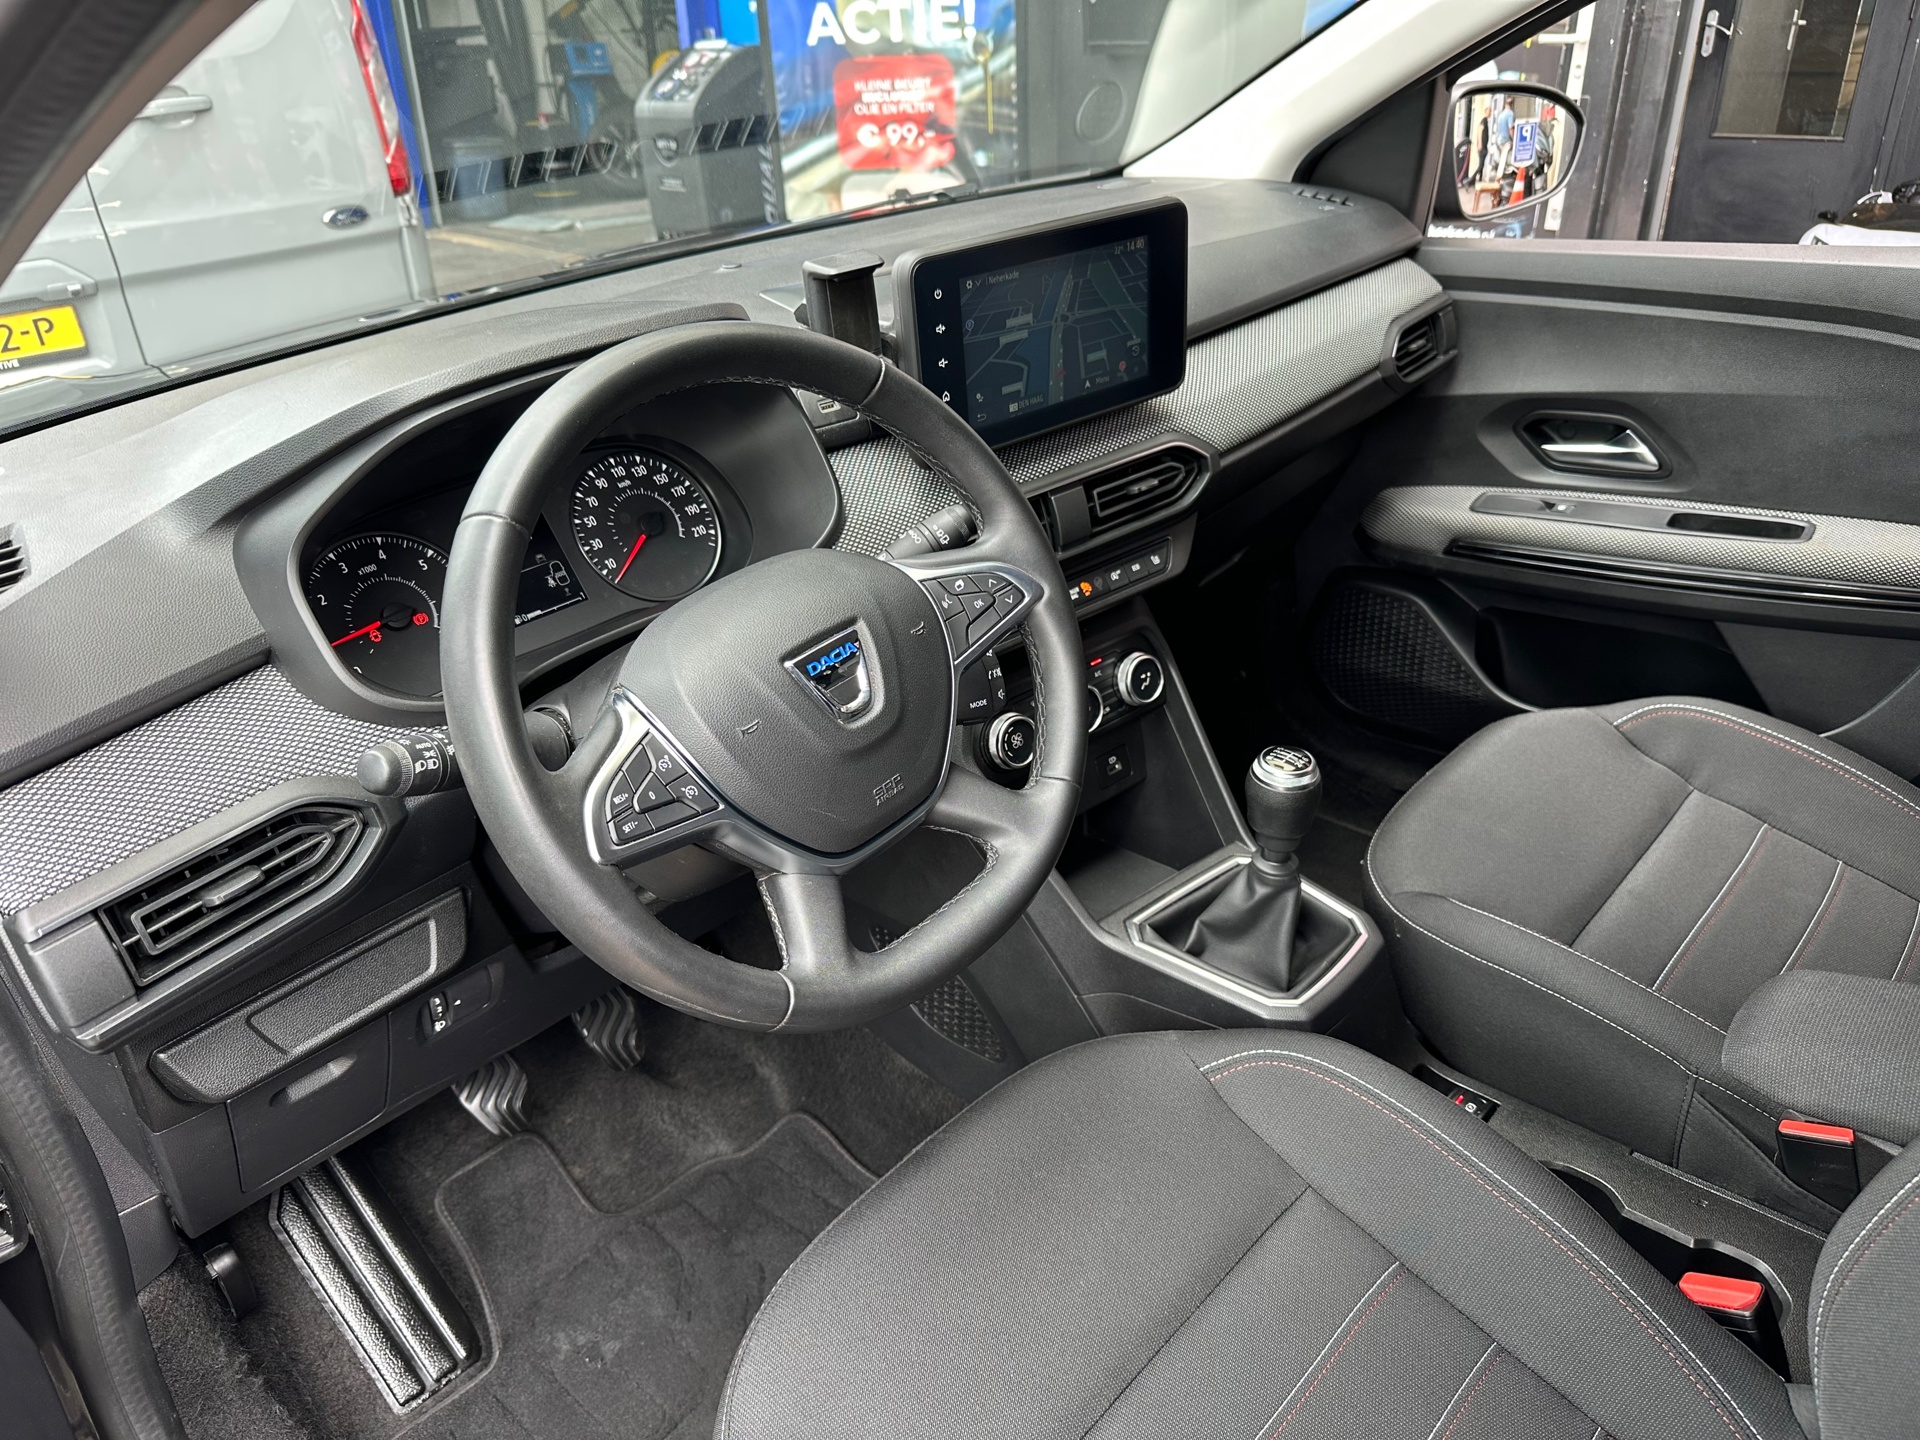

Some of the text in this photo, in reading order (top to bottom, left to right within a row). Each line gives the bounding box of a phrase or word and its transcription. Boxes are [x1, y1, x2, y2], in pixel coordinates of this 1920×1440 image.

[806, 0, 977, 46] ACTIE!
[611, 465, 626, 478] 110
[631, 465, 648, 478] 130
[595, 478, 608, 490] 90
[653, 473, 669, 486] 150
[671, 485, 686, 498] 170
[585, 496, 599, 508] 70
[684, 503, 700, 516] 190
[583, 517, 597, 528] 50
[691, 525, 707, 538] 210
[589, 538, 603, 550] 30
[378, 549, 387, 560] 4
[338, 562, 349, 574] 3
[357, 563, 378, 576] x1000
[418, 559, 428, 571] 5
[604, 558, 617, 570] 10
[317, 594, 328, 606] 2
[974, 599, 985, 609] OK
[806, 641, 858, 676] DACIA
[969, 698, 988, 709] MODE
